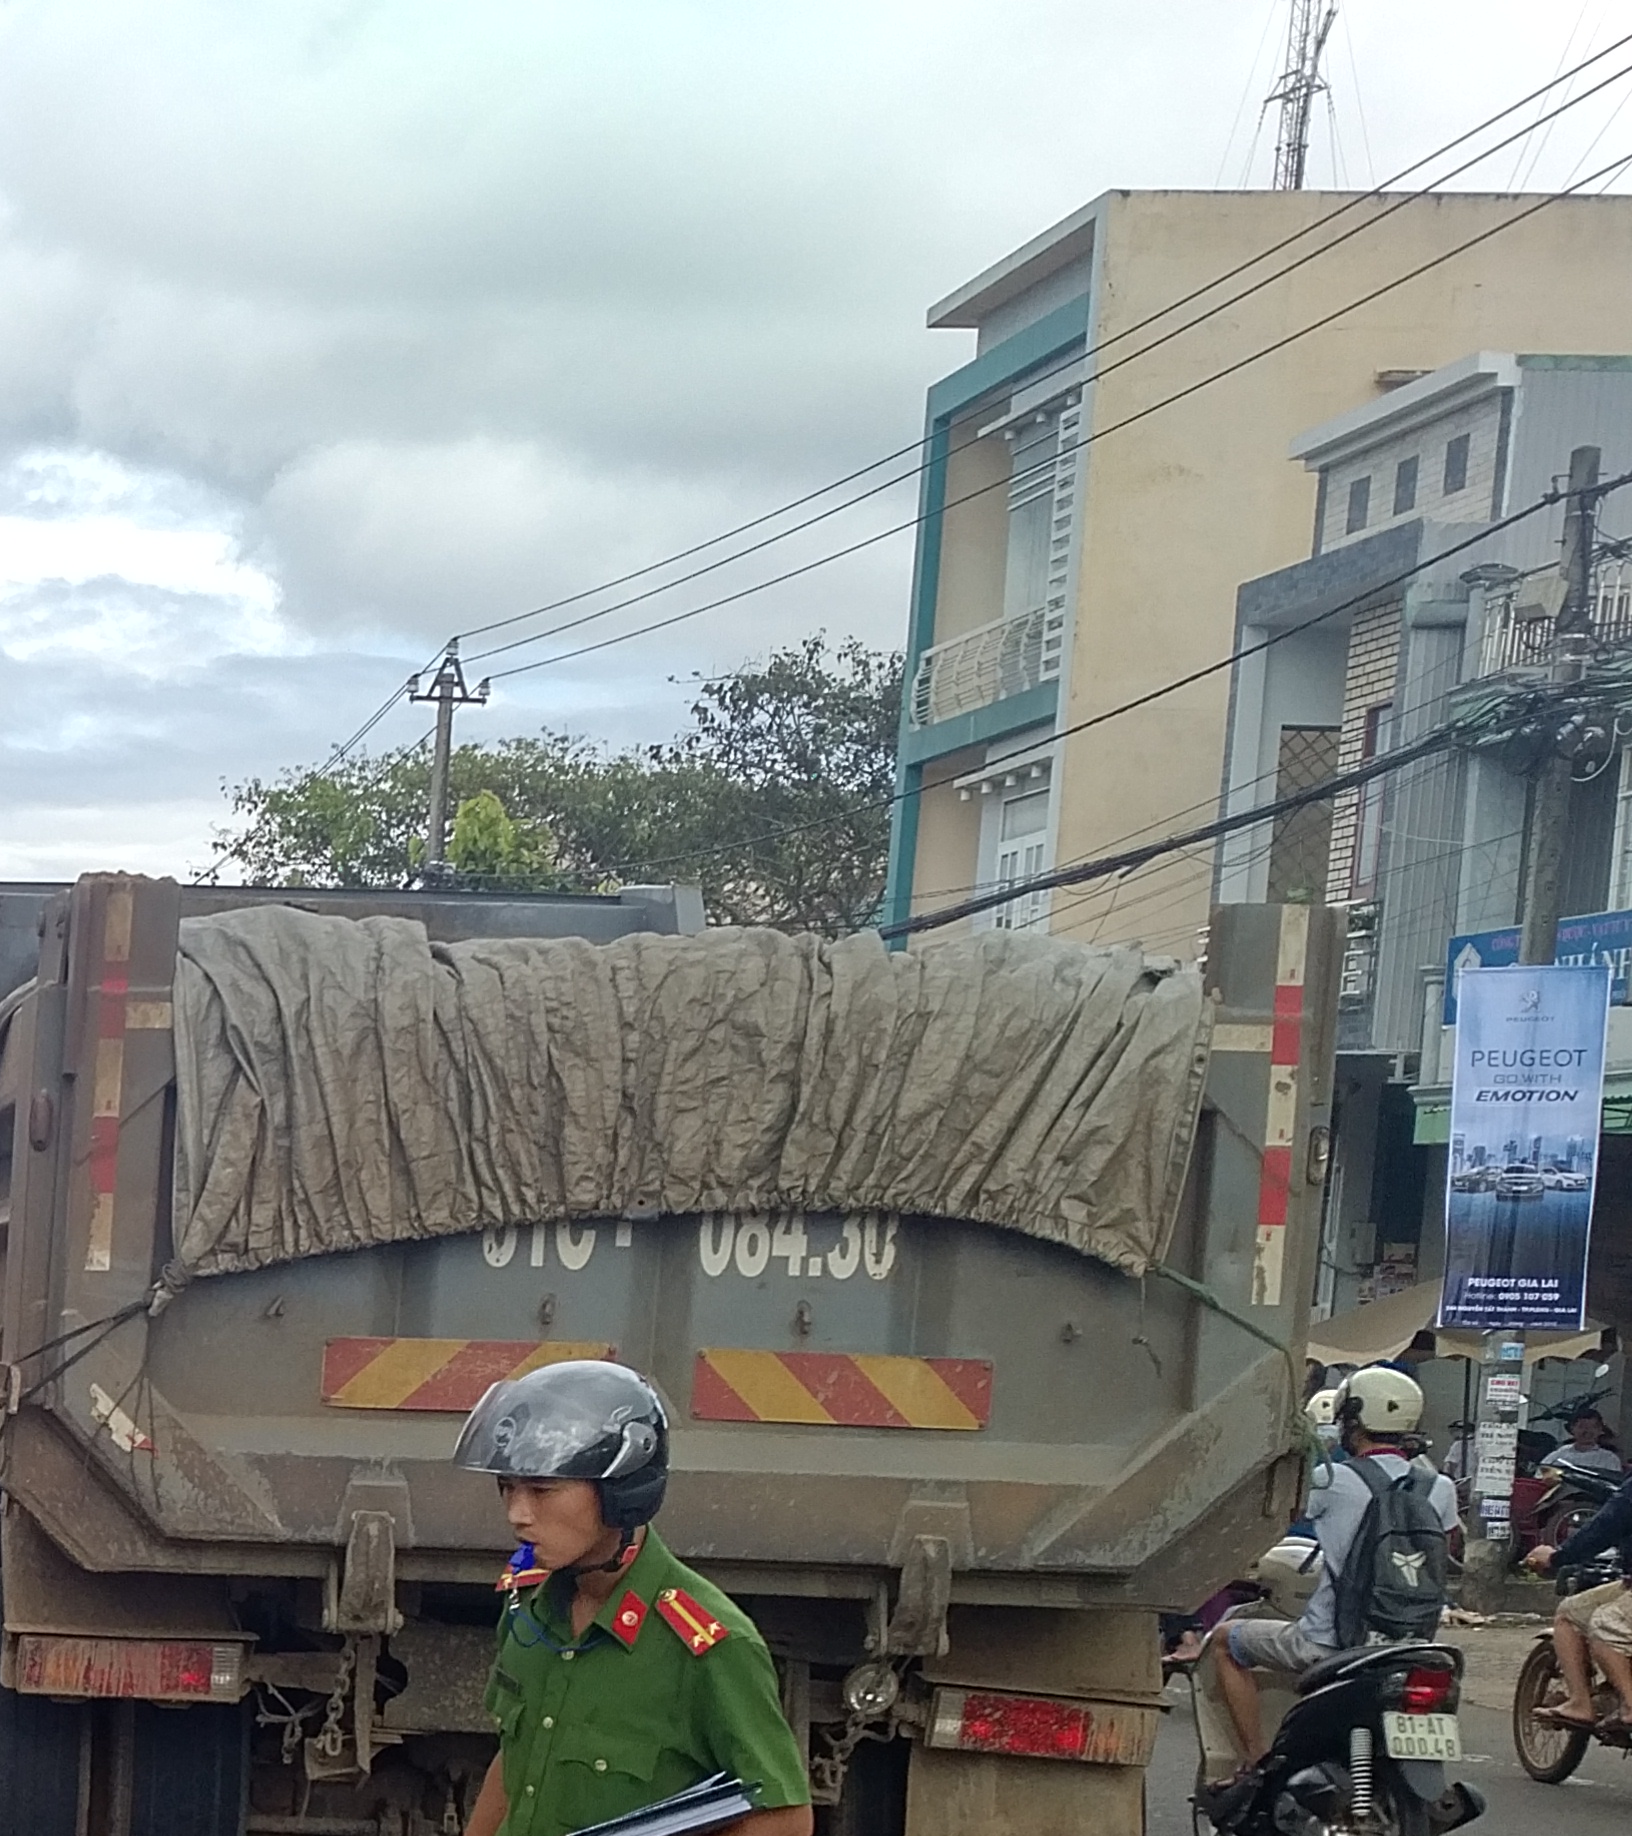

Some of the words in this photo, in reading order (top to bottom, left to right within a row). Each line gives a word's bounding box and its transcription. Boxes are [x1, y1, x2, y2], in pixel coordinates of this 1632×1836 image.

[1471, 1049, 1588, 1067] PEUGEOT
[1494, 1074, 1518, 1084] GO
[1521, 1073, 1562, 1084] WITH
[1475, 1090, 1579, 1102] EMOTION
[1468, 1278, 1516, 1288] PEUGEOT
[1518, 1278, 1539, 1288] GIA
[1541, 1279, 1559, 1288] LAI
[1397, 1715, 1444, 1736] 81-AT
[1393, 1736, 1456, 1757] 000.48
